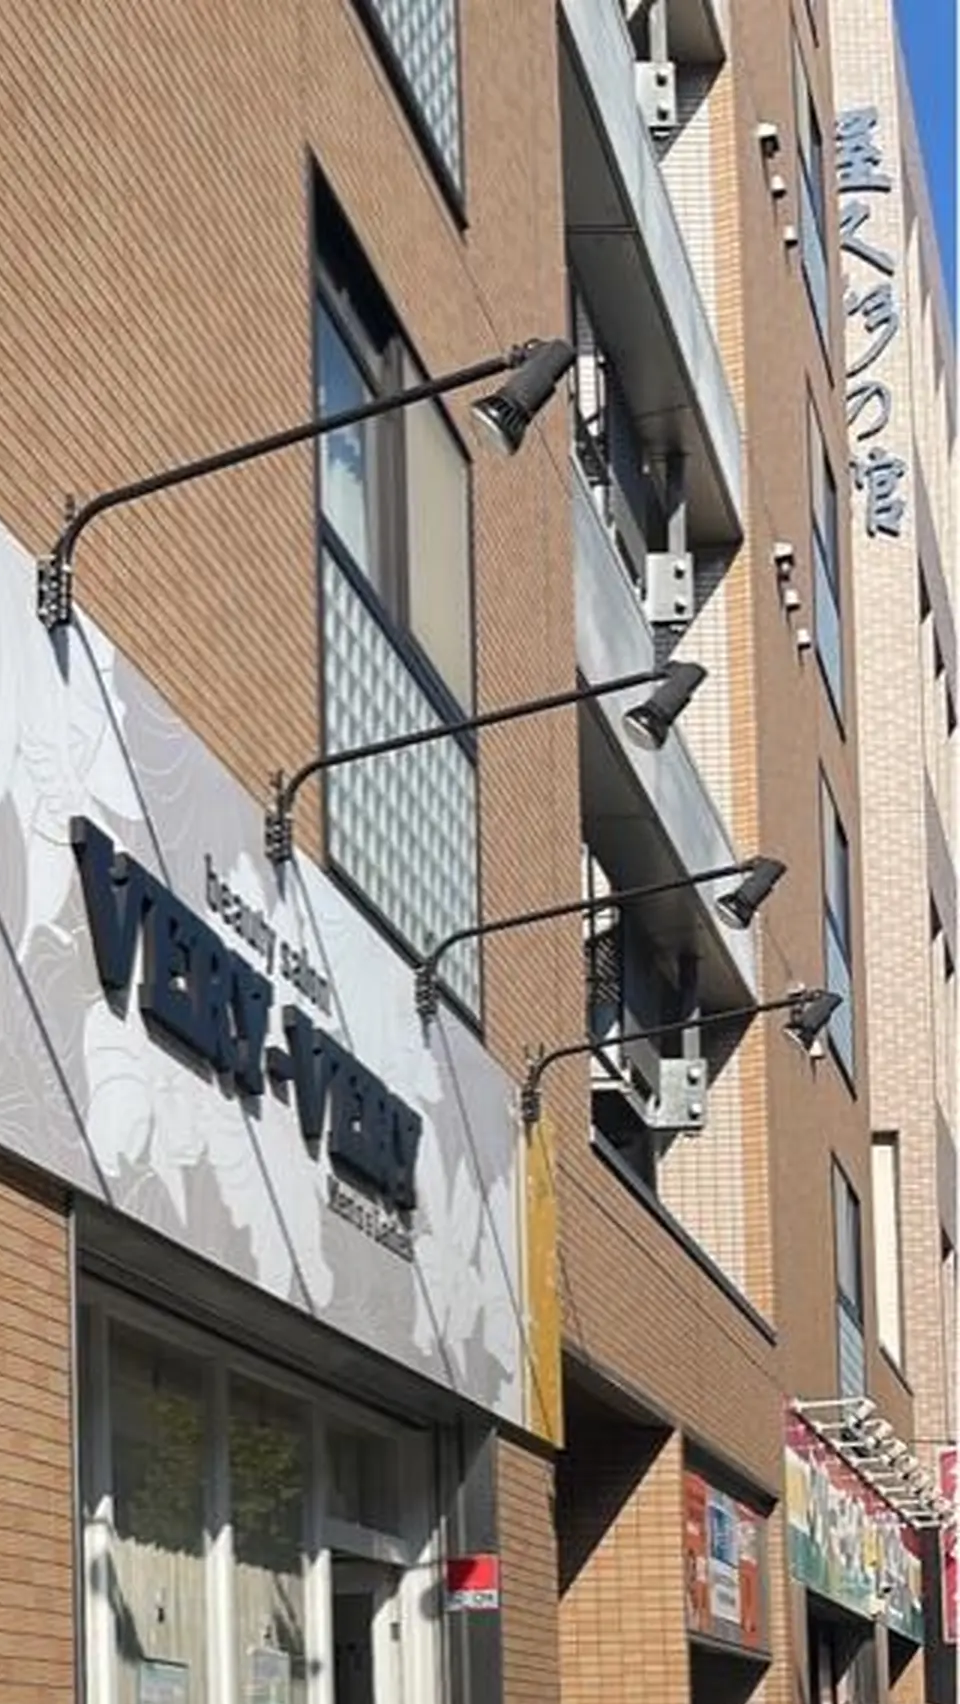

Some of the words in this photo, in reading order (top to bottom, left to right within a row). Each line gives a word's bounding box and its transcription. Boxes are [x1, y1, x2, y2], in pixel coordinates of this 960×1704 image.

[70, 815, 424, 1216] VERY-VERY
[204, 853, 277, 976] beauty
[280, 940, 332, 1018] salon
